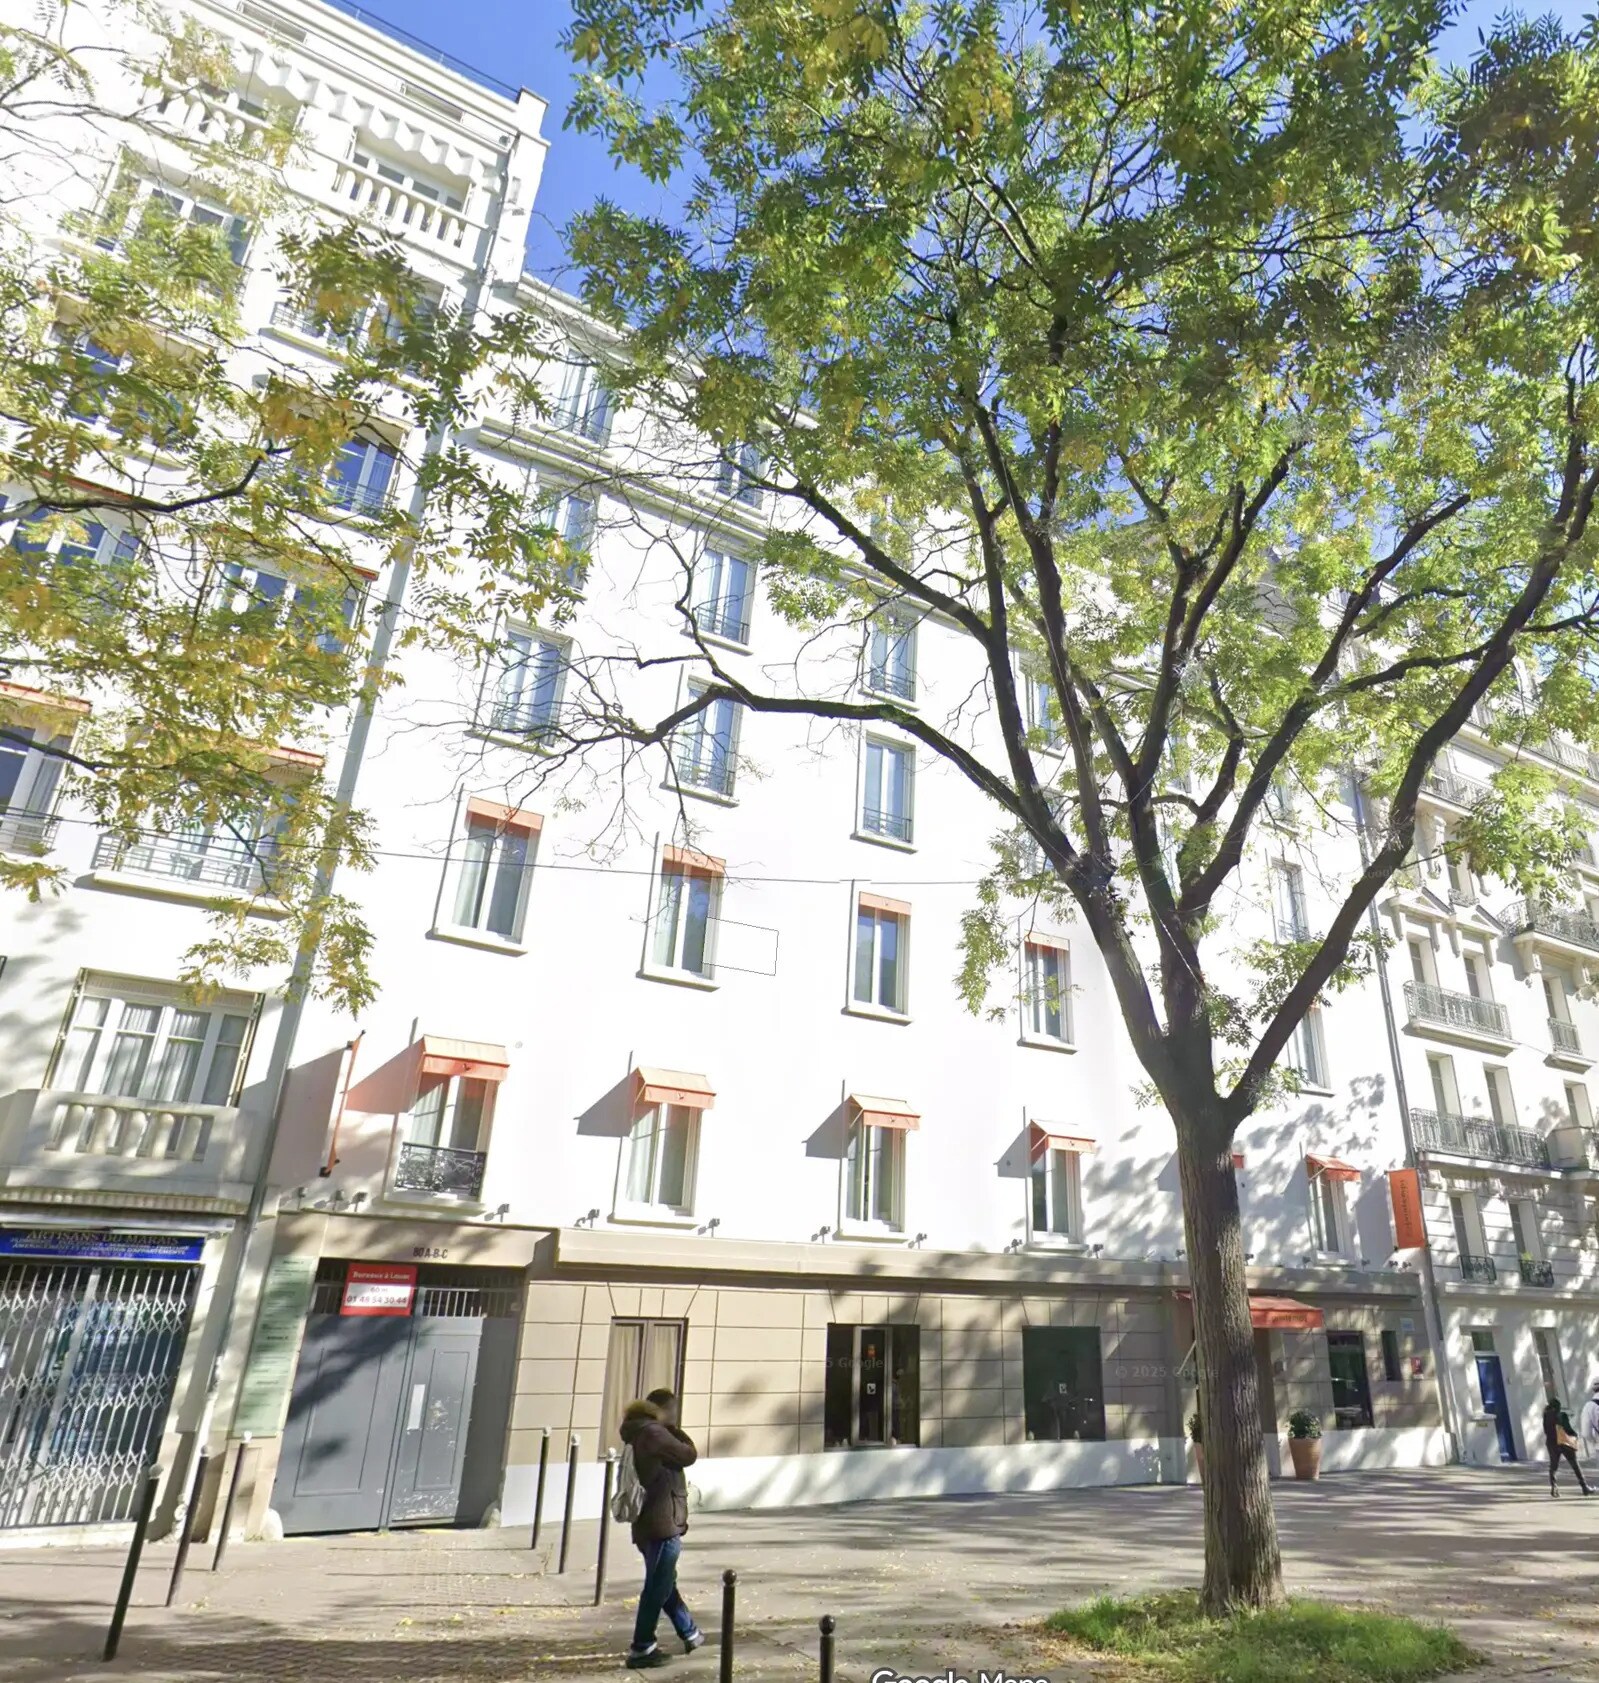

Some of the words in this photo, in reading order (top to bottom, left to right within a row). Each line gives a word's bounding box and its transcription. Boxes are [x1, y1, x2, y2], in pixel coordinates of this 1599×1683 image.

[26, 1230, 98, 1242] ARTISANS
[102, 1232, 124, 1243] DU
[125, 1234, 179, 1246] MARAIS
